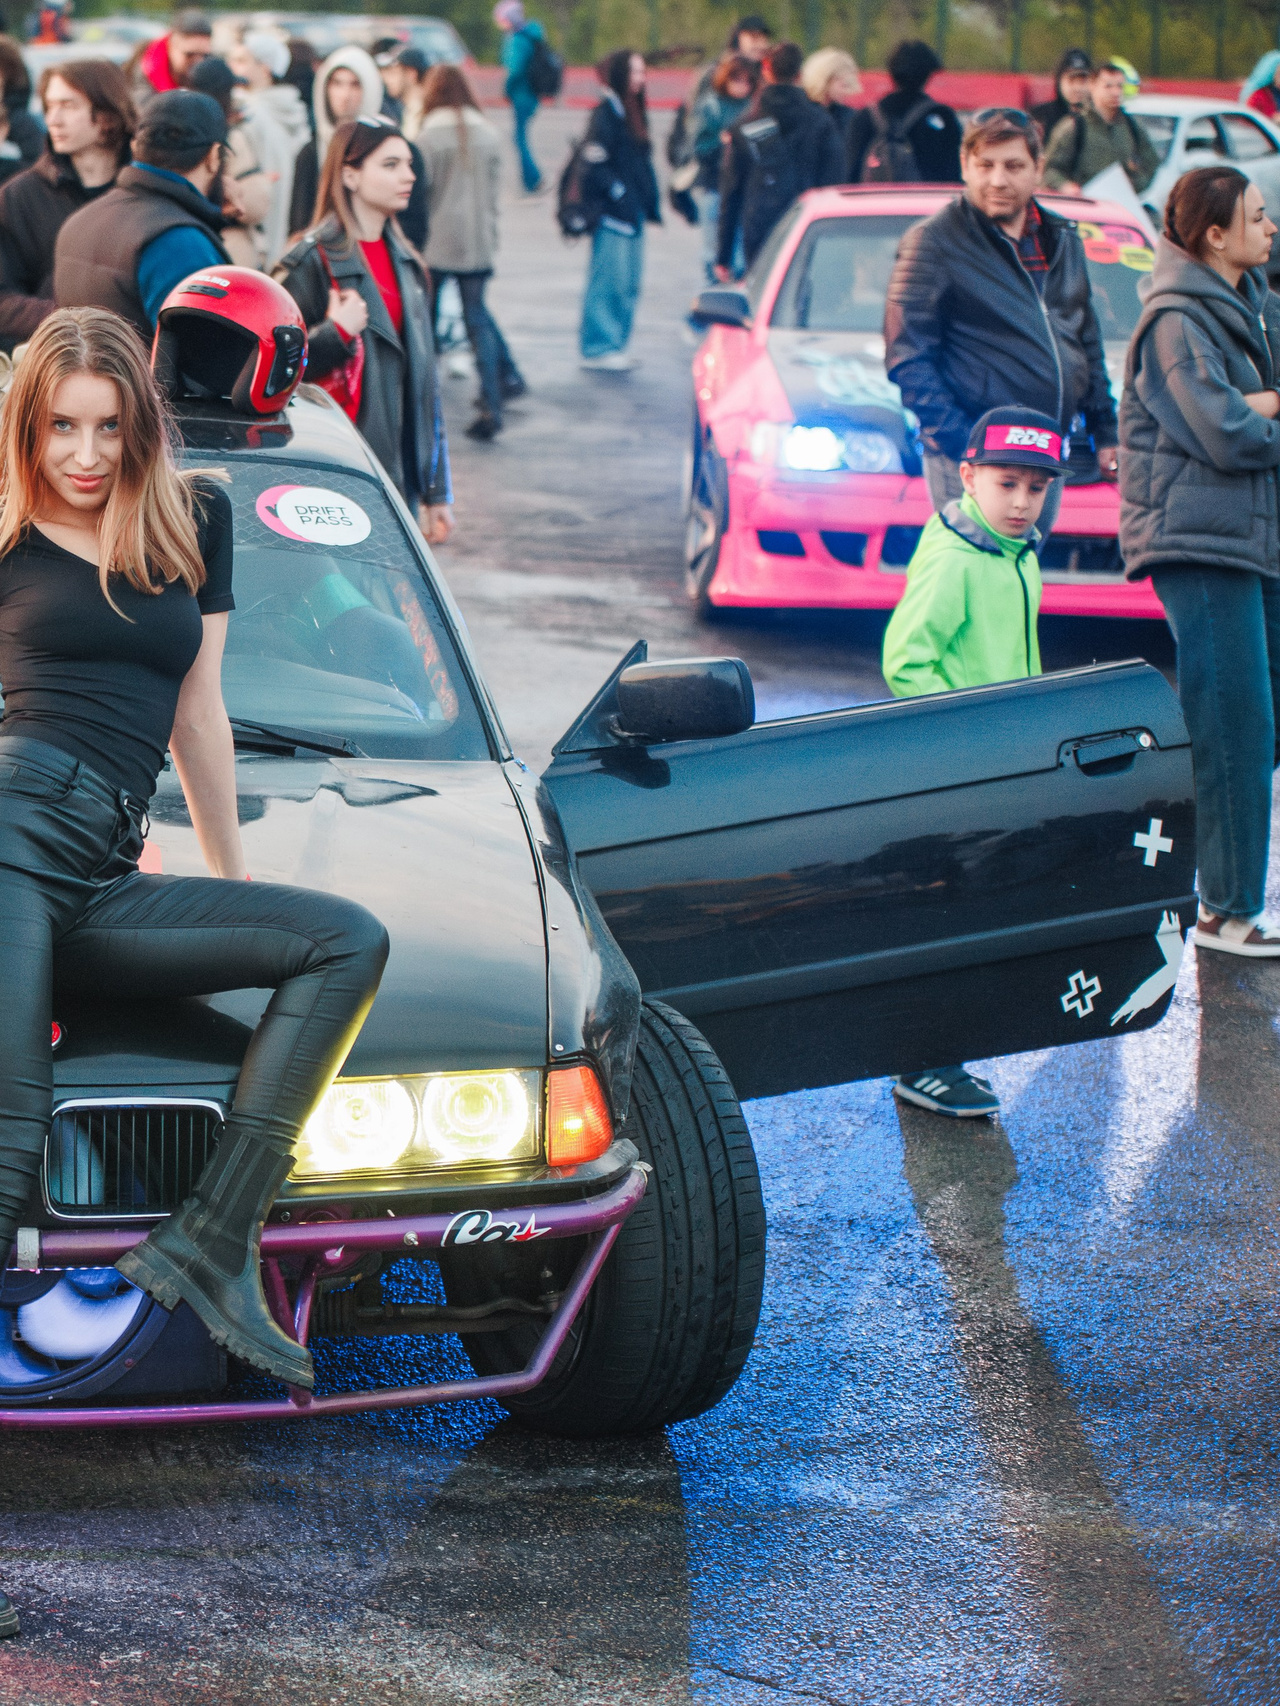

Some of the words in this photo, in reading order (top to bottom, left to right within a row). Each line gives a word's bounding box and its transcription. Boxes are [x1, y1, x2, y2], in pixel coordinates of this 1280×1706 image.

[1004, 427, 1052, 450] RDS
[294, 506, 346, 515] DRIFT
[300, 516, 353, 526] PASS
